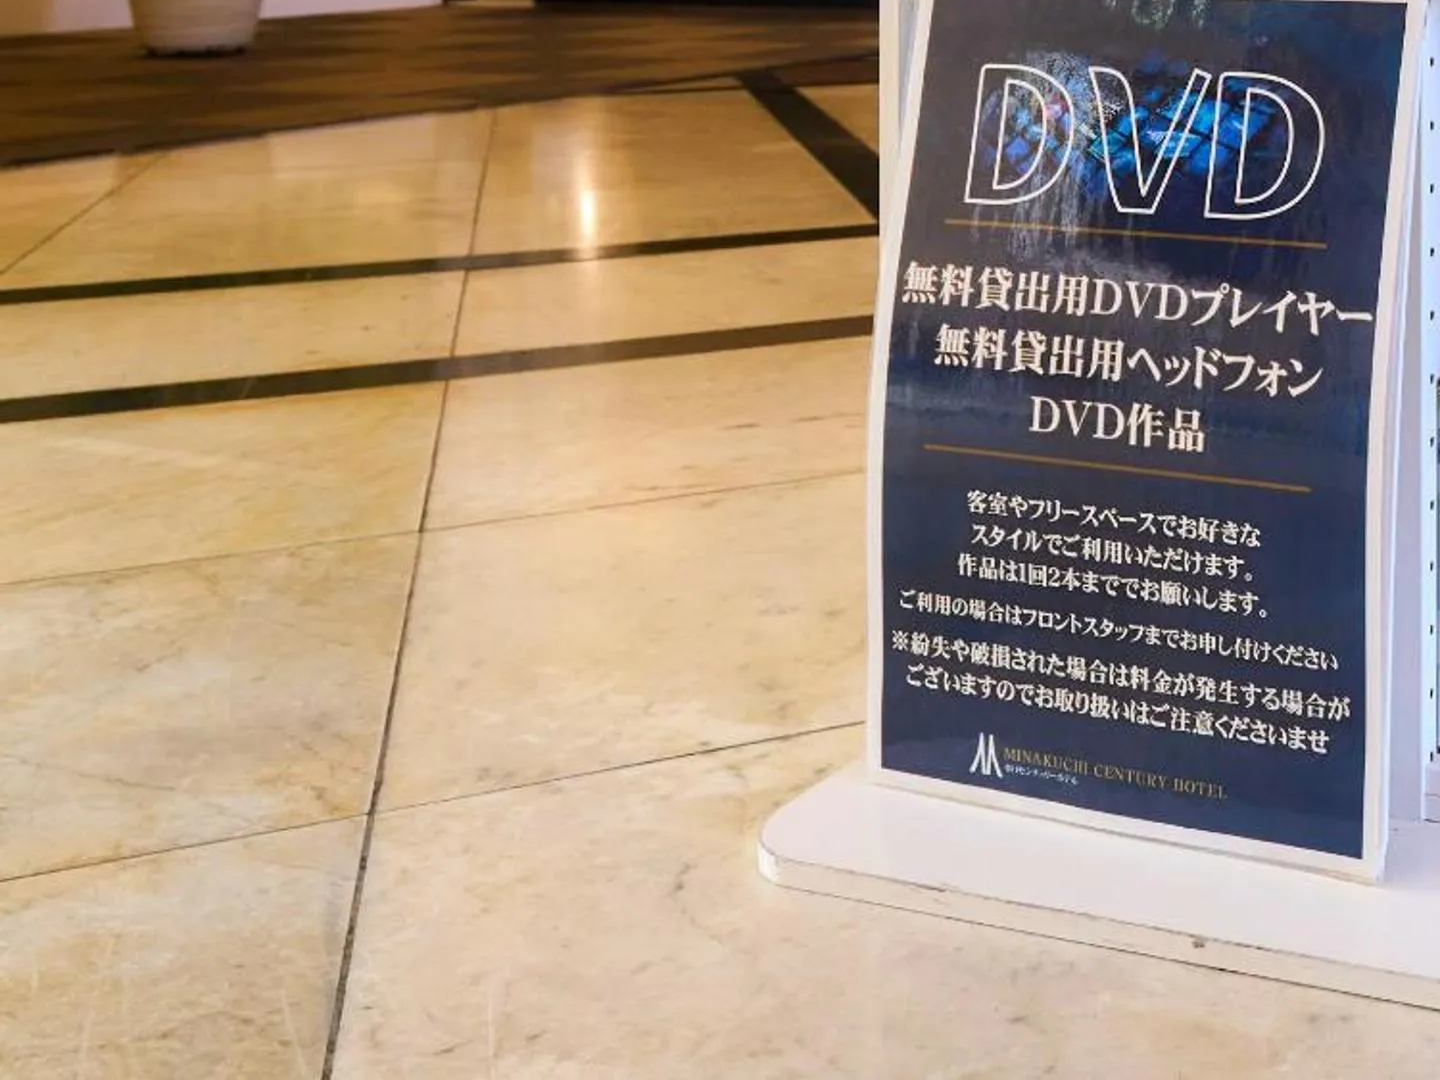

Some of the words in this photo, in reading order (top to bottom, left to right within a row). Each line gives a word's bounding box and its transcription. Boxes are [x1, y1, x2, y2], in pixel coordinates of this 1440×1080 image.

[964, 63, 1325, 219] DVD
[901, 260, 1373, 335] 無料貸出用DVDプレイヤー
[934, 324, 1323, 397] 無料貸出用ヘッドフォン
[1029, 395, 1206, 453] DVD作品
[967, 490, 1261, 547] 客室やフリースペースでお好きな
[971, 524, 1253, 581] スタイルでご利用いただけます。
[958, 553, 1267, 618] 作品は1回2本まででお願いします。
[900, 589, 1339, 670] ご利用の場合はフロントスタッフまでお申し付けください
[906, 663, 1329, 754] ございますのでお取り扱いはご注意くださいませ
[1003, 747, 1089, 775] MINAKUCHI
[1093, 763, 1168, 789] CENTURY
[1173, 778, 1227, 800] HOTEL
